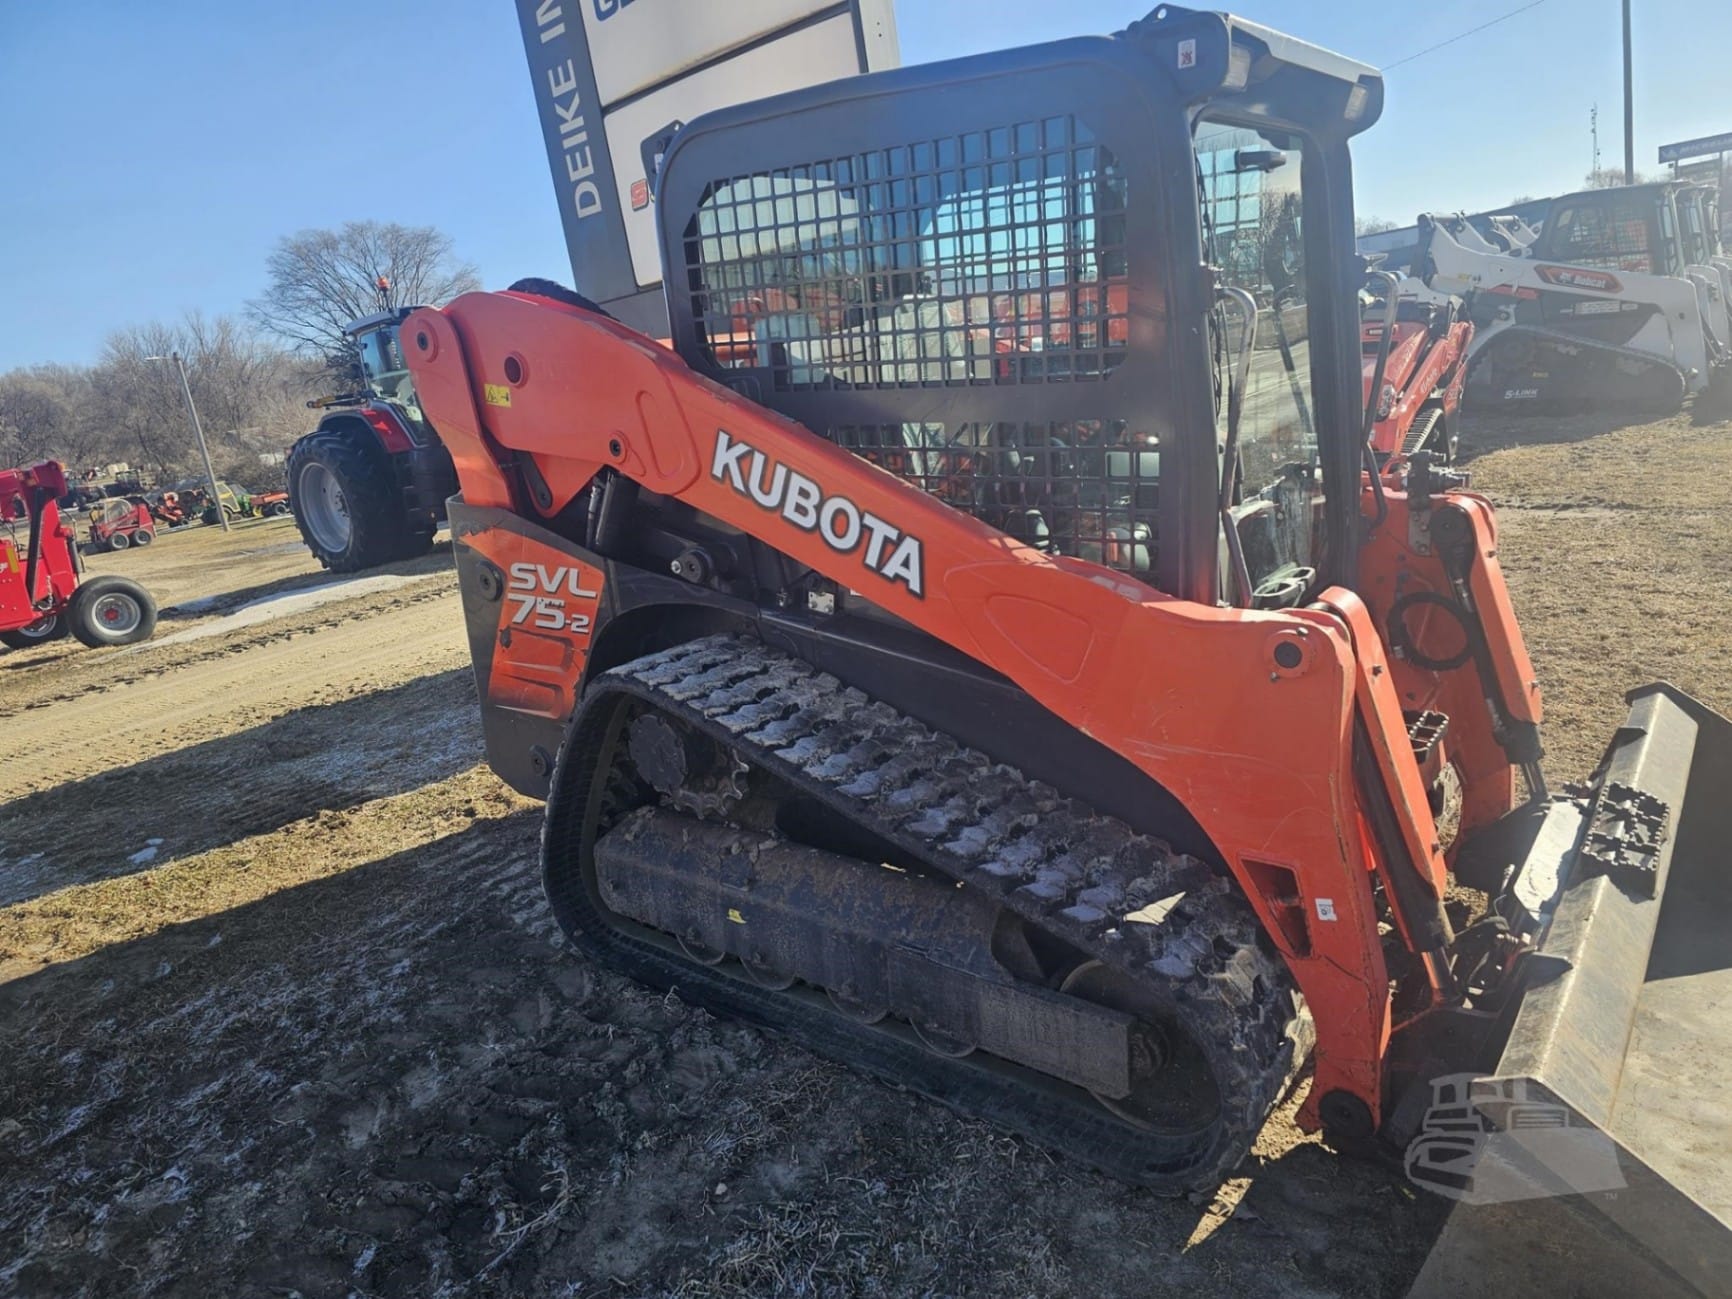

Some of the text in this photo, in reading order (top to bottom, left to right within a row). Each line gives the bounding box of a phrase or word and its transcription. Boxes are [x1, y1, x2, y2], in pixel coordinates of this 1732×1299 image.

[548, 58, 602, 219] DEIKE
[509, 562, 597, 598] SVL
[711, 430, 923, 595] KUBOTA
